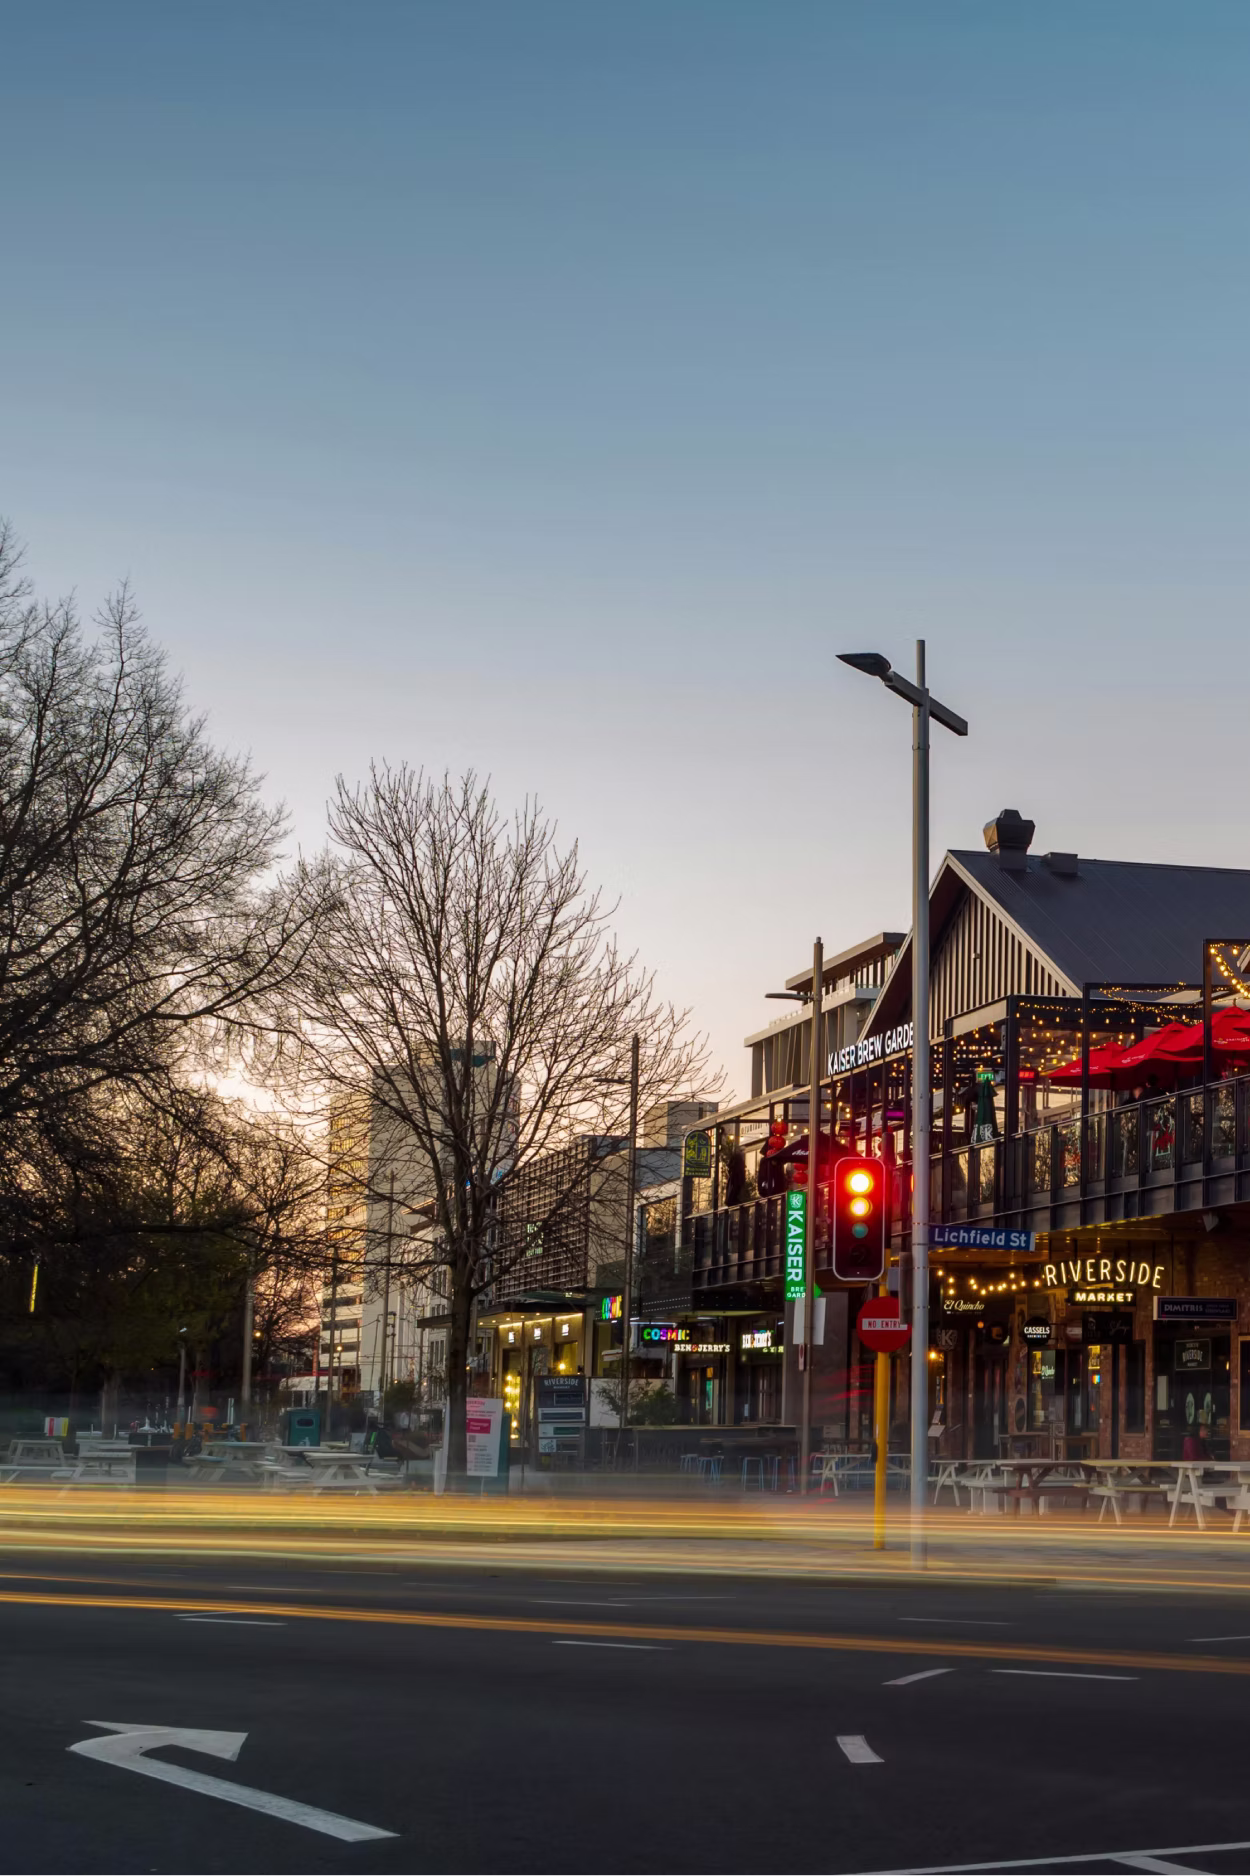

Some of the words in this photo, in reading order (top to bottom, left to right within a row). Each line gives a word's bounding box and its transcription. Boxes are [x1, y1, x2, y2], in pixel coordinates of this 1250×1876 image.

[827, 1045, 857, 1076] KAISER
[857, 1033, 883, 1066] BREW
[884, 1021, 914, 1055] GARDE
[934, 1228, 1005, 1246] Lichfield
[1010, 1232, 1027, 1247] St
[787, 1210, 804, 1282] KAISER
[1045, 1259, 1165, 1289] RIVERSIDE
[1074, 1291, 1134, 1302] MARKET
[943, 1298, 956, 1311] El
[954, 1299, 985, 1312] Quincho
[1164, 1304, 1203, 1313] DIMITRIS
[867, 1319, 877, 1328] NO
[643, 1328, 690, 1341] COSMIC
[1024, 1325, 1051, 1335] CASSELS
[674, 1343, 691, 1352] BEN
[698, 1343, 731, 1353] JERRY'S
[544, 1377, 579, 1387] RIVERSIDE
